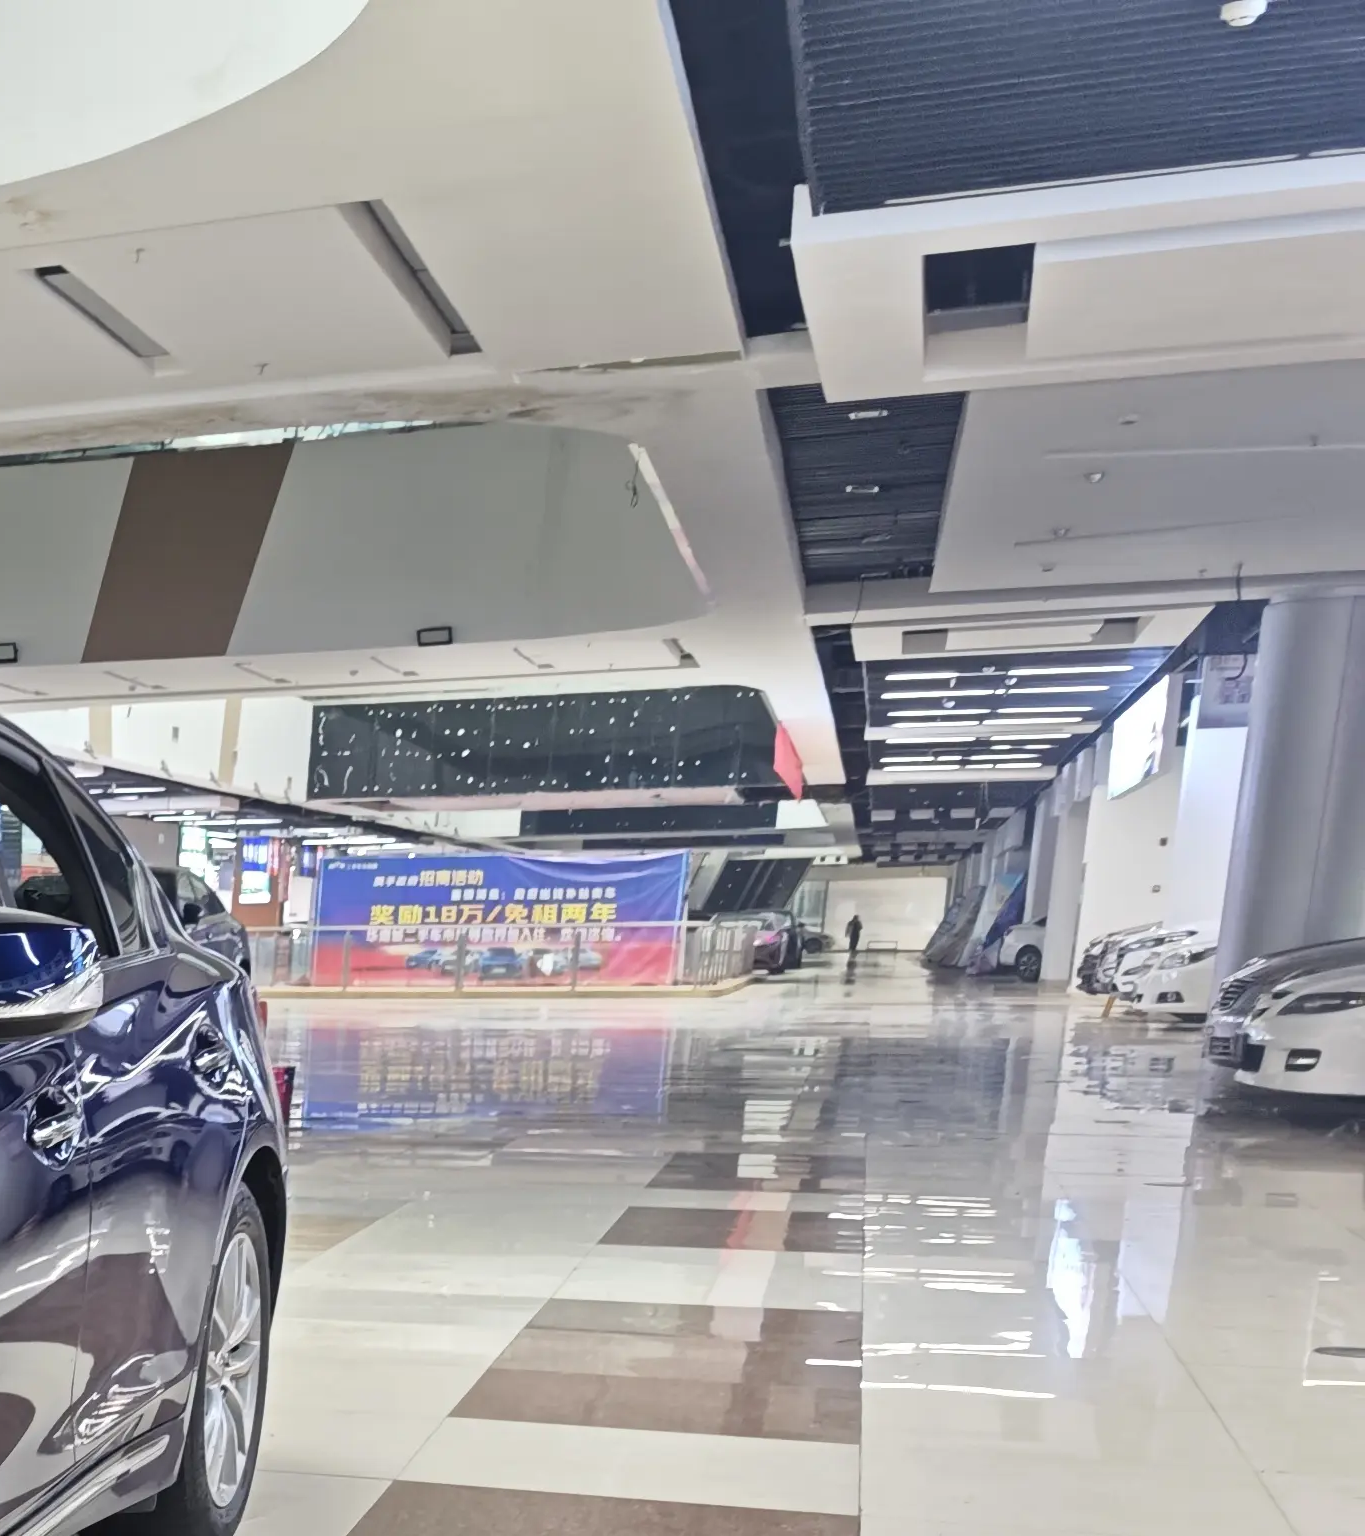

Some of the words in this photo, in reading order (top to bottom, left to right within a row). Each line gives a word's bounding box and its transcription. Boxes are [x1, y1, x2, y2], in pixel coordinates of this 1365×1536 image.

[369, 903, 617, 926] 奖励18万/免租两年
